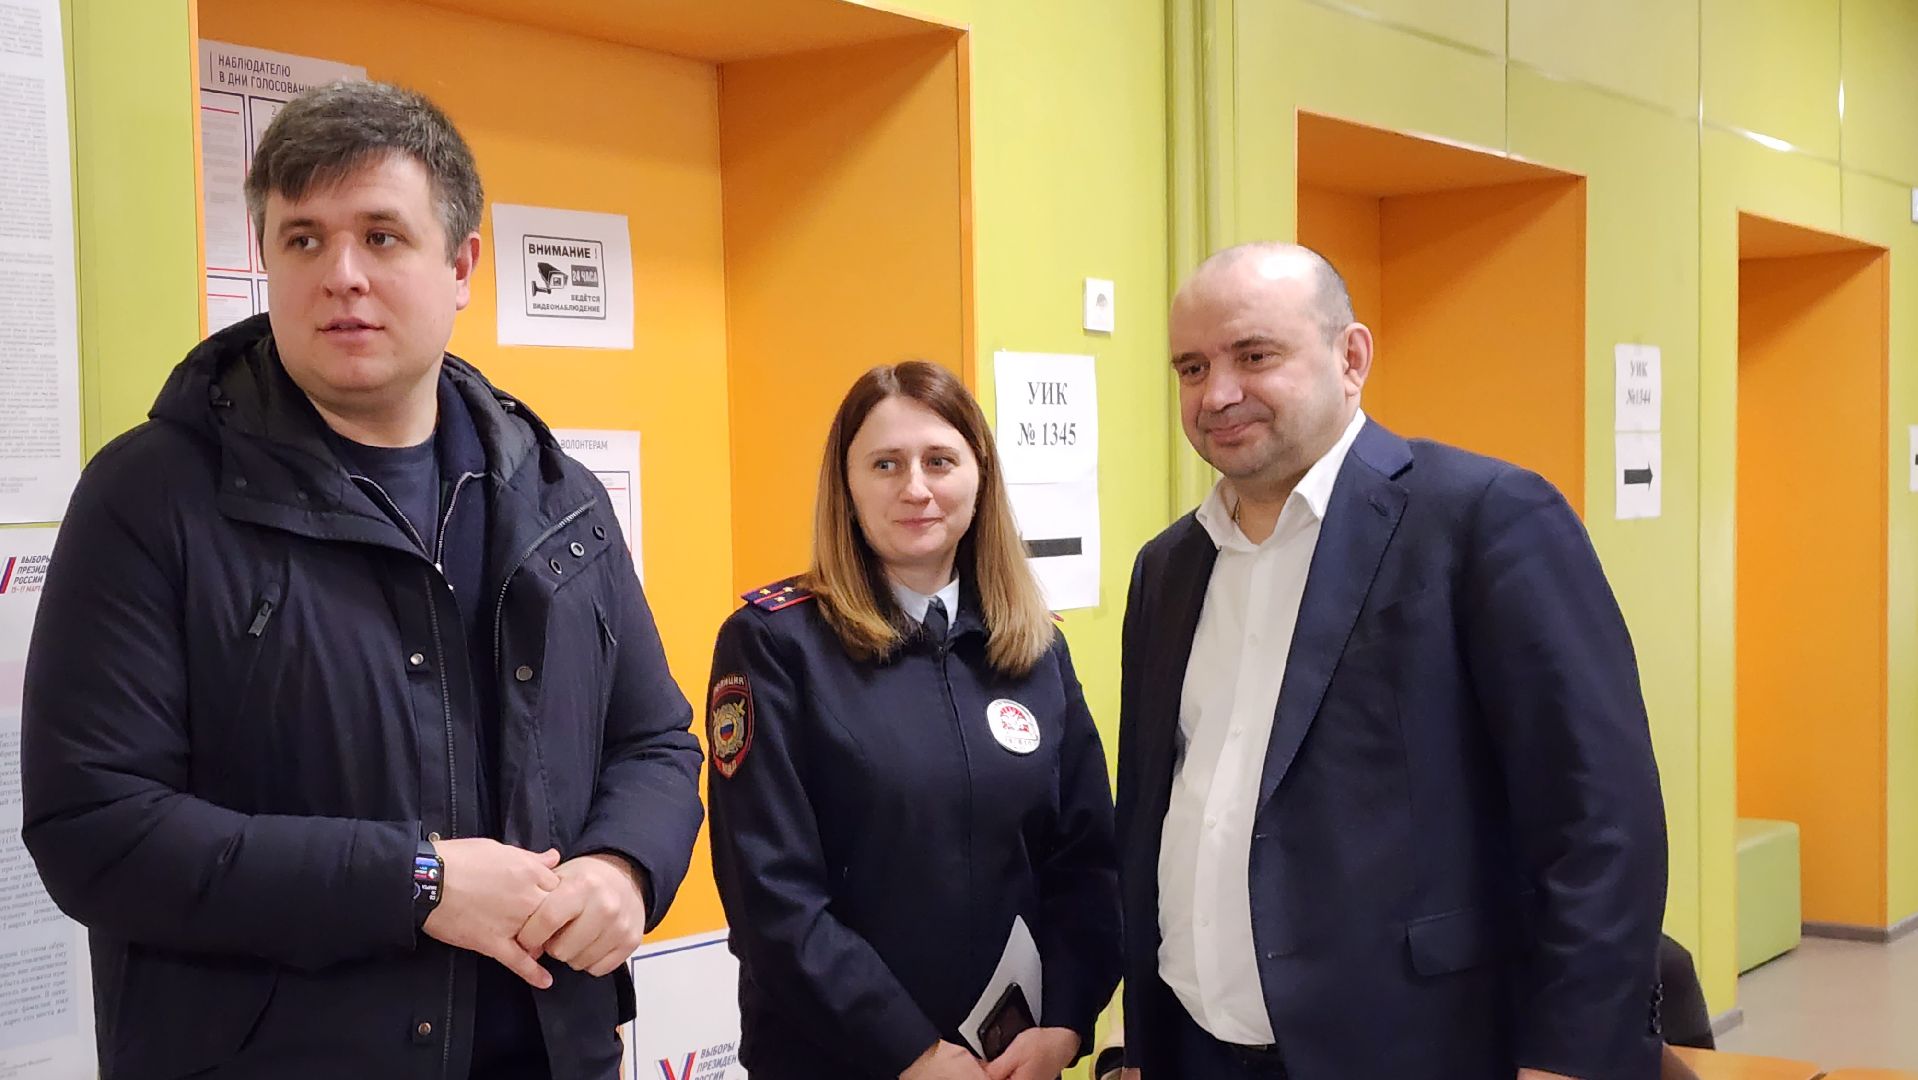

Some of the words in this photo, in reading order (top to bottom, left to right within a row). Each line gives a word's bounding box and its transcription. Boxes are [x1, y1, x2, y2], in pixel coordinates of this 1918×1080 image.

[218, 54, 291, 77] НАБЛЮДАТЕЛЮ
[219, 71, 225, 83] В
[228, 72, 248, 88] ДНИ
[250, 76, 311, 95] ГОЛОСОВАНИ
[528, 243, 591, 259] ВНИМАНИЕ
[572, 270, 581, 282] 24
[581, 271, 598, 284] ЧАСА
[532, 302, 601, 313] ВИДЕОНАБЛЮДЕНИЕ
[1630, 359, 1648, 377] УИК
[1028, 381, 1068, 405] УИК
[1017, 422, 1036, 446] №
[1043, 422, 1077, 446] 1345
[17, 565, 47, 575] ПРЕЗИД
[13, 576, 44, 585] РОССИИ
[700, 1041, 736, 1059] ВЫБОРЫ
[696, 1054, 738, 1073] ПРЕЗИДЕН
